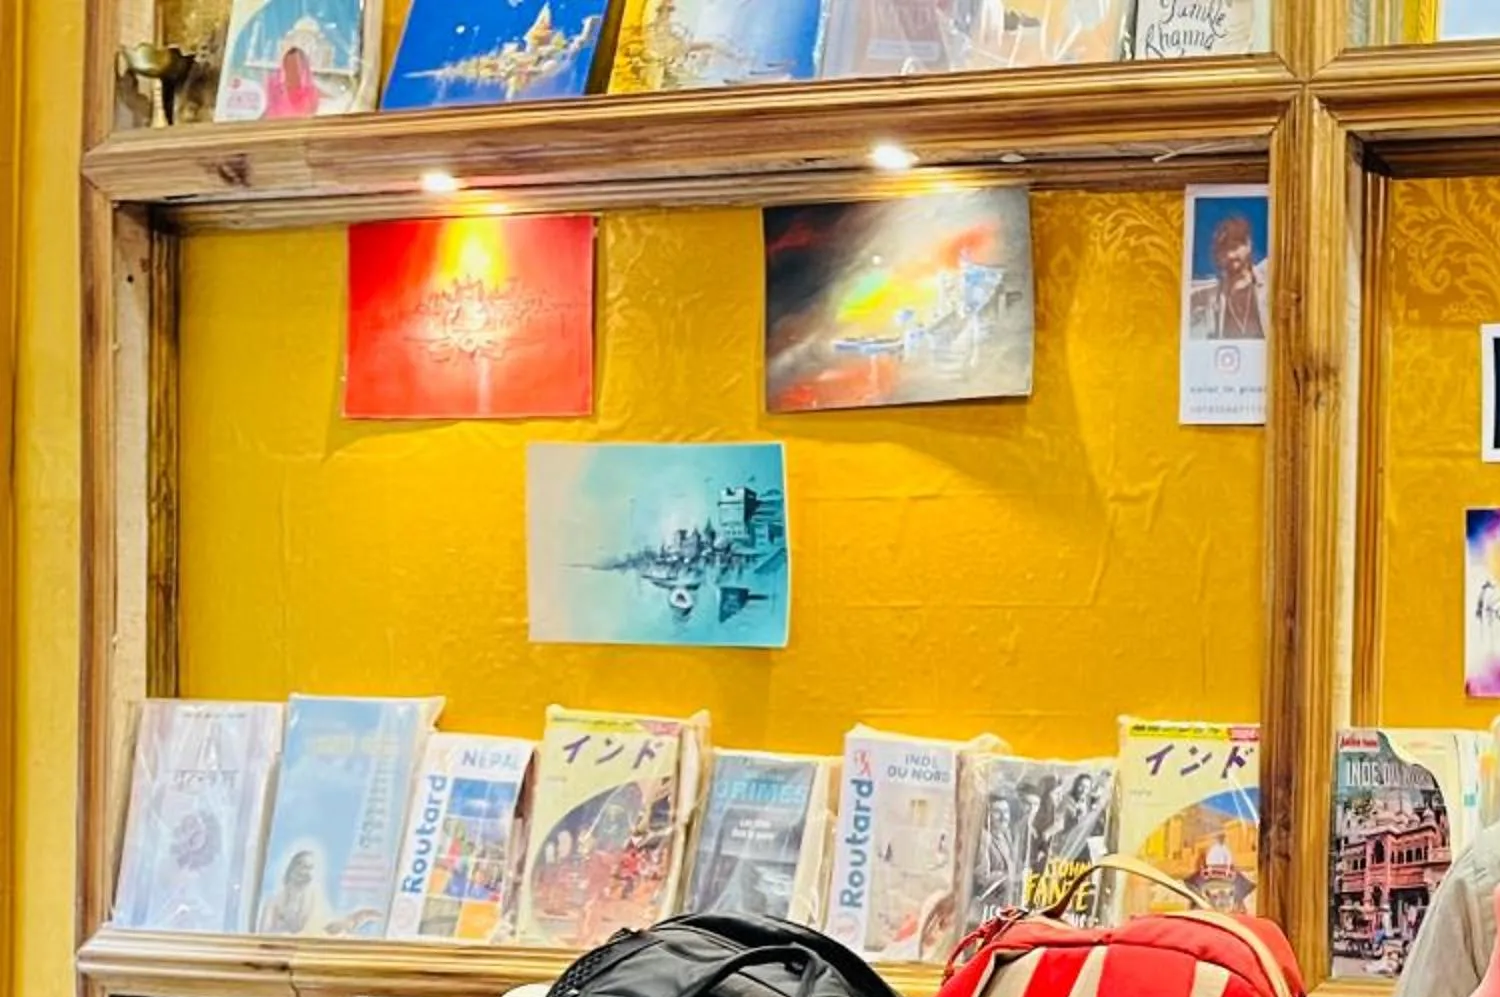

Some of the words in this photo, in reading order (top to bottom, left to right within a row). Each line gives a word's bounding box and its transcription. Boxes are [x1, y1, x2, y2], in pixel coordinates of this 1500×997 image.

[562, 735, 664, 769] インド
[1145, 743, 1254, 779] インド
[887, 765, 907, 779] DU
[1346, 760, 1379, 786] INDE
[402, 774, 447, 893] Routard
[839, 779, 874, 908] Routard
[1023, 872, 1091, 912] FANE
